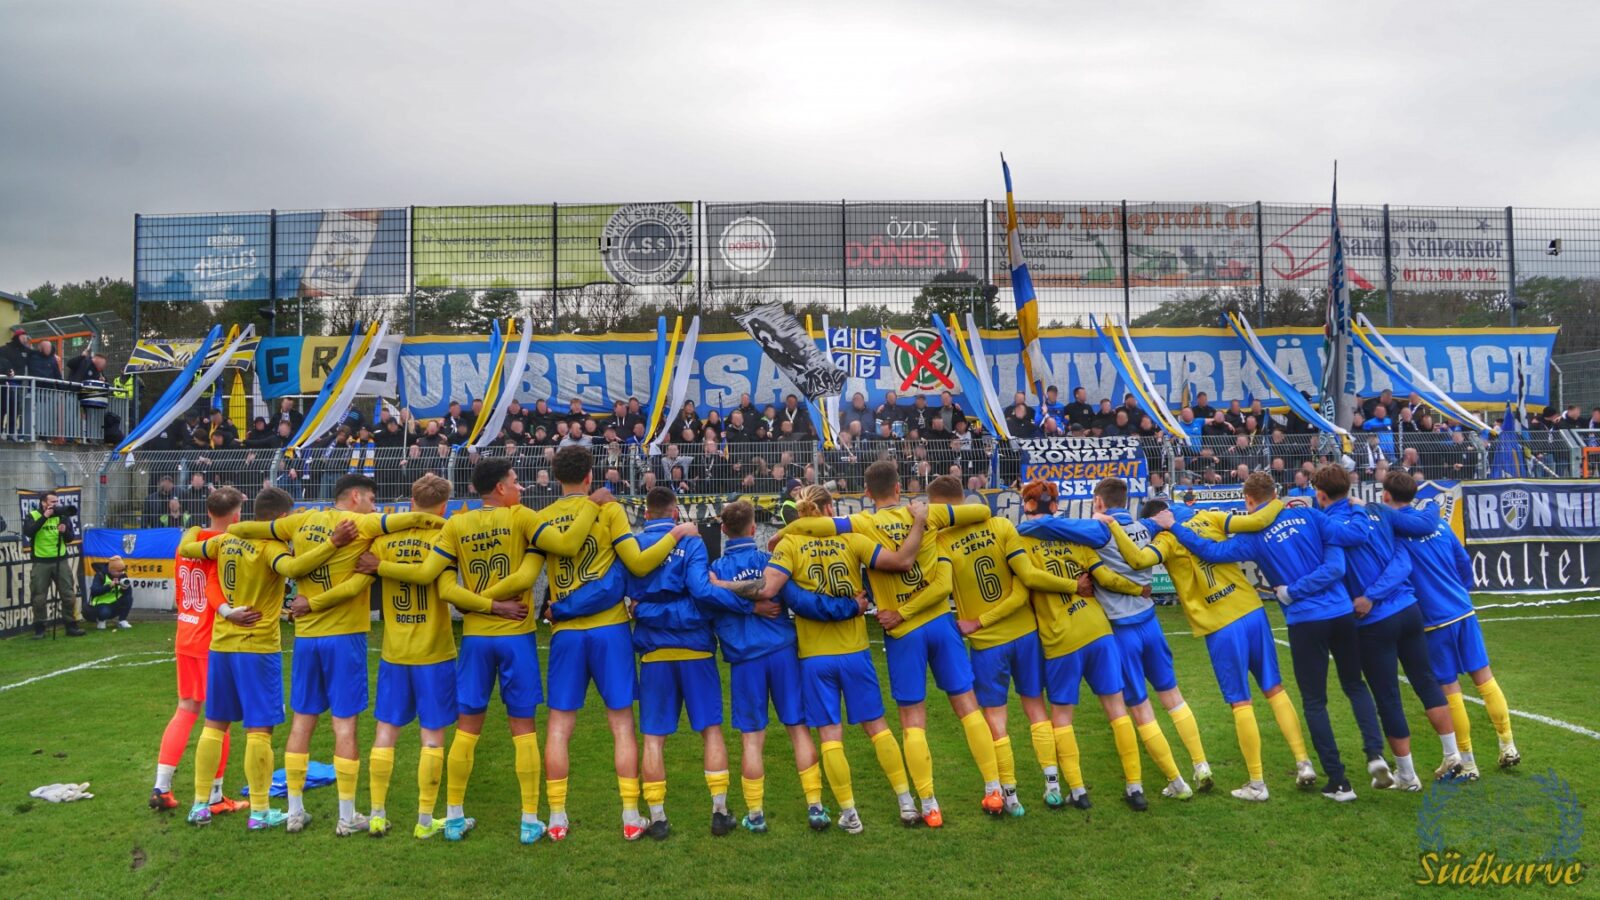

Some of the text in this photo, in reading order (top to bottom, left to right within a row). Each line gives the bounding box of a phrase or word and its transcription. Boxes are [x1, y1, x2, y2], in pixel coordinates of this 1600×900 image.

[886, 216, 940, 239] ÖZDE
[1361, 217, 1437, 233] Malbetrieb
[1000, 233, 1049, 244] Vkauf
[1343, 236, 1503, 258] Sando Schleusner
[845, 235, 947, 267] DÖNER
[1000, 248, 1073, 260] Vmietung
[1457, 268, 1472, 281] 50
[1476, 268, 1497, 281] 912
[970, 337, 1548, 404] UNVERKÄFLICH
[1020, 436, 1140, 450] ZUKUNFTS
[1028, 447, 1137, 464] KONZEPT
[1026, 460, 1142, 480] KONSEQUENT
[461, 536, 471, 545] FC
[472, 531, 490, 542] CARL
[472, 538, 502, 552] JENA
[951, 543, 960, 552] FC
[961, 532, 979, 546] CARL
[964, 538, 995, 556] JENA
[974, 555, 1003, 603] 6
[179, 565, 209, 613] 30
[1205, 583, 1237, 605] VERKAMP
